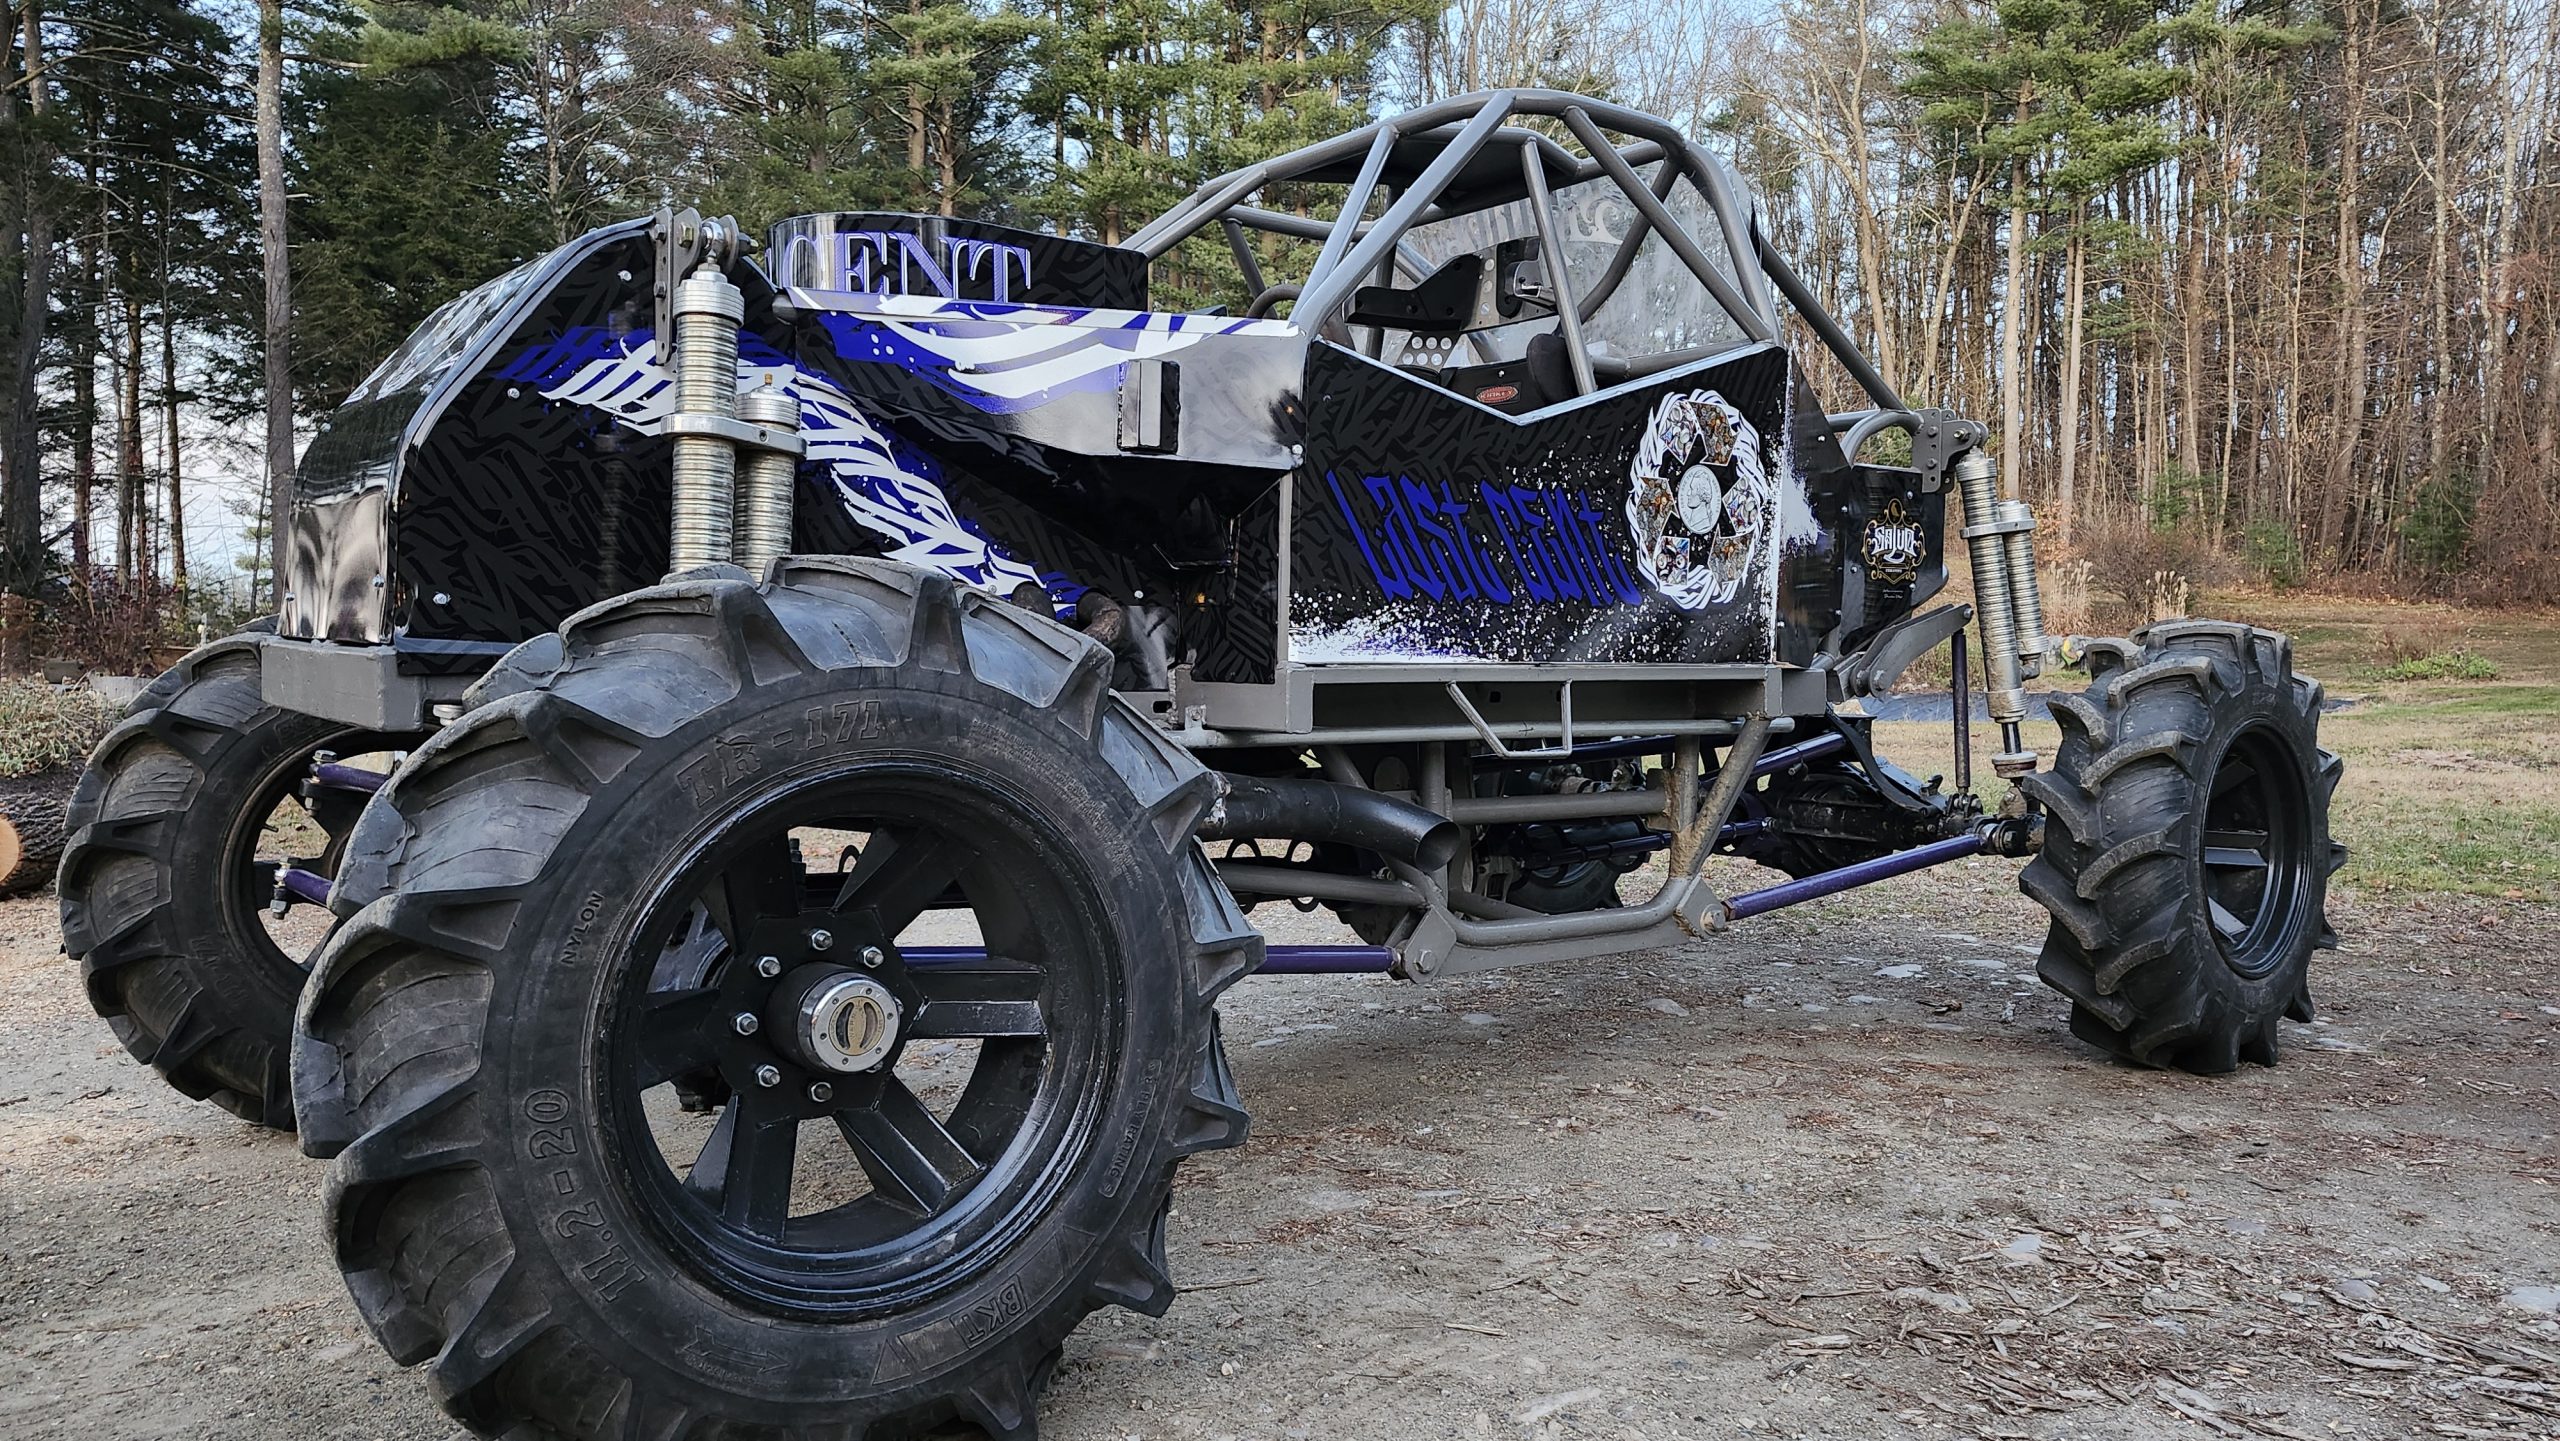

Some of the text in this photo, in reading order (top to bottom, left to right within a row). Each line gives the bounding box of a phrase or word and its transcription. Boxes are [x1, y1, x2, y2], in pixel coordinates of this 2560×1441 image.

[782, 230, 1031, 303] CENT
[560, 891, 604, 966] NYLON
[1134, 1092, 1150, 1119] PLY
[1109, 1124, 1140, 1179] RATING
[524, 1089, 647, 1303] 11.2-20
[961, 1282, 1024, 1342] BKT
